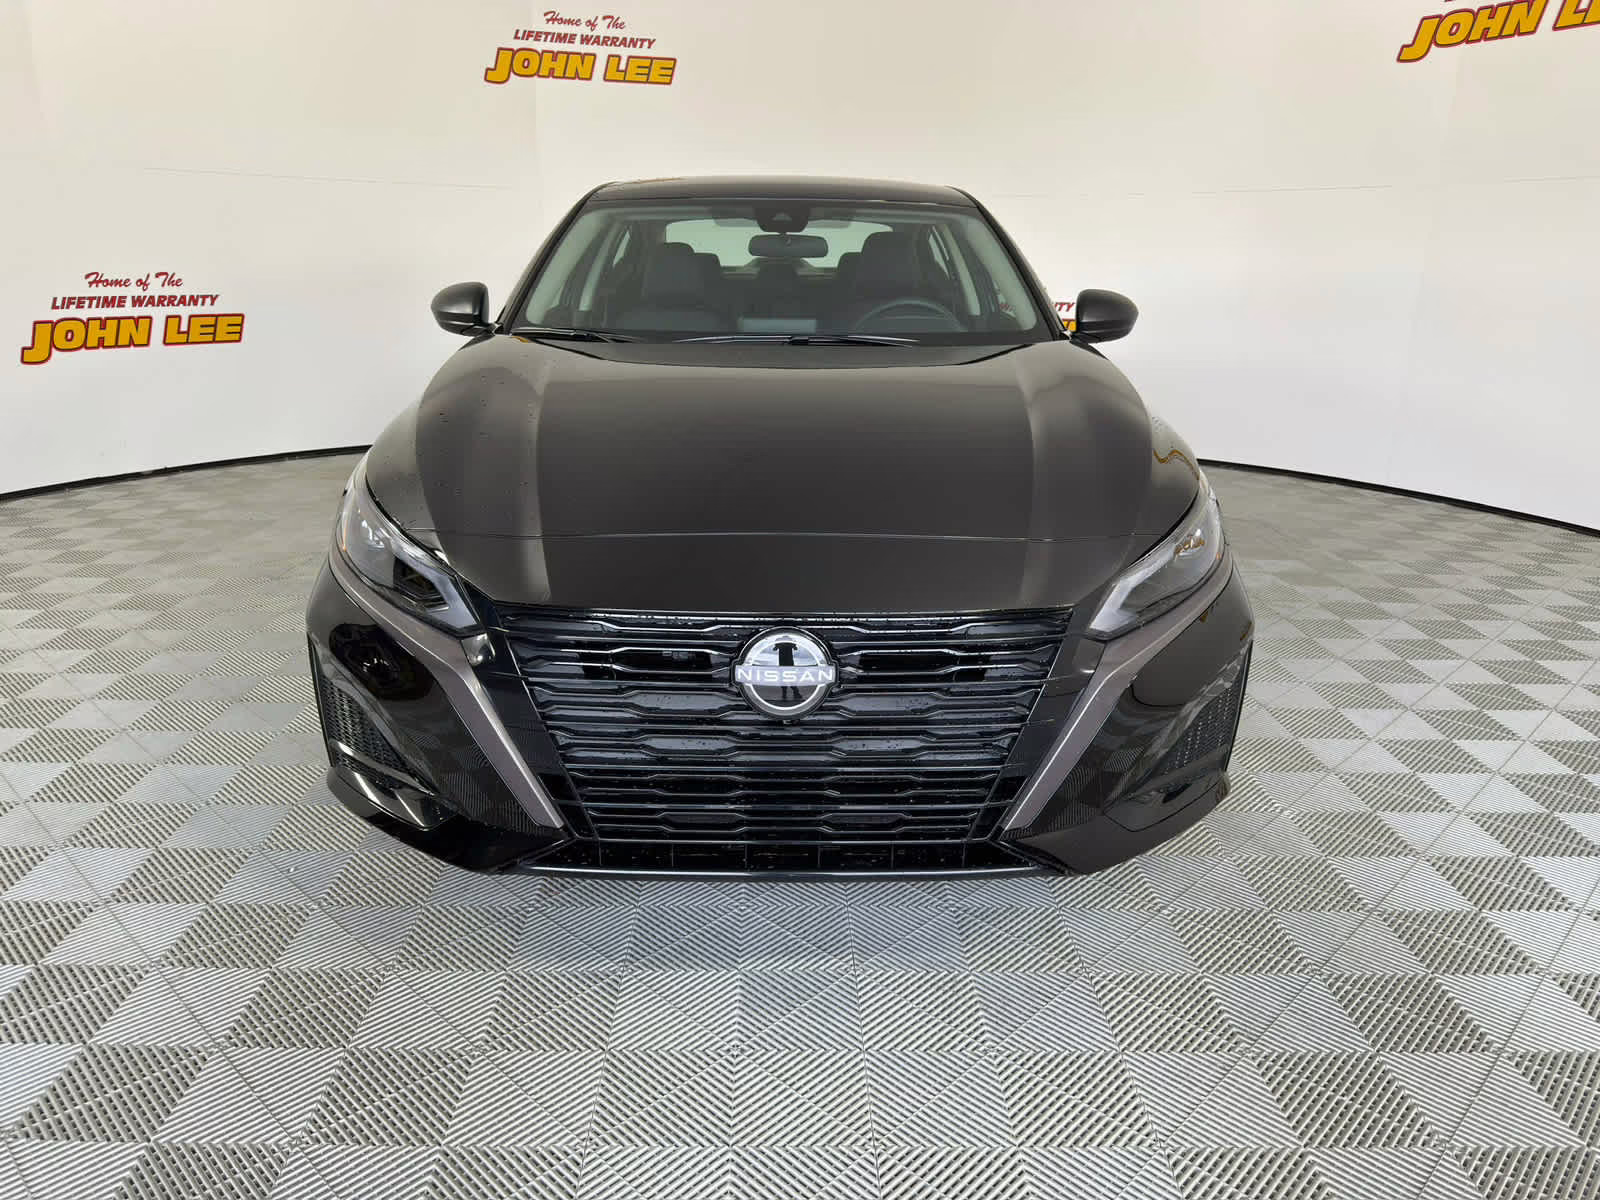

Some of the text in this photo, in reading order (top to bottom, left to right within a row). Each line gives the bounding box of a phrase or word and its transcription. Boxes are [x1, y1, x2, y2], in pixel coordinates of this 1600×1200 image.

[543, 10, 626, 31] Home of The
[513, 29, 656, 49] LIFETIME WARRANTY
[1397, 0, 1549, 63] JOHN
[484, 47, 677, 85] JOHN LEE
[84, 272, 183, 291] Home of The
[51, 294, 219, 310] LIFETIME WARRANTY
[20, 313, 245, 365] JOHN LEE
[737, 669, 832, 682] NISSAN
